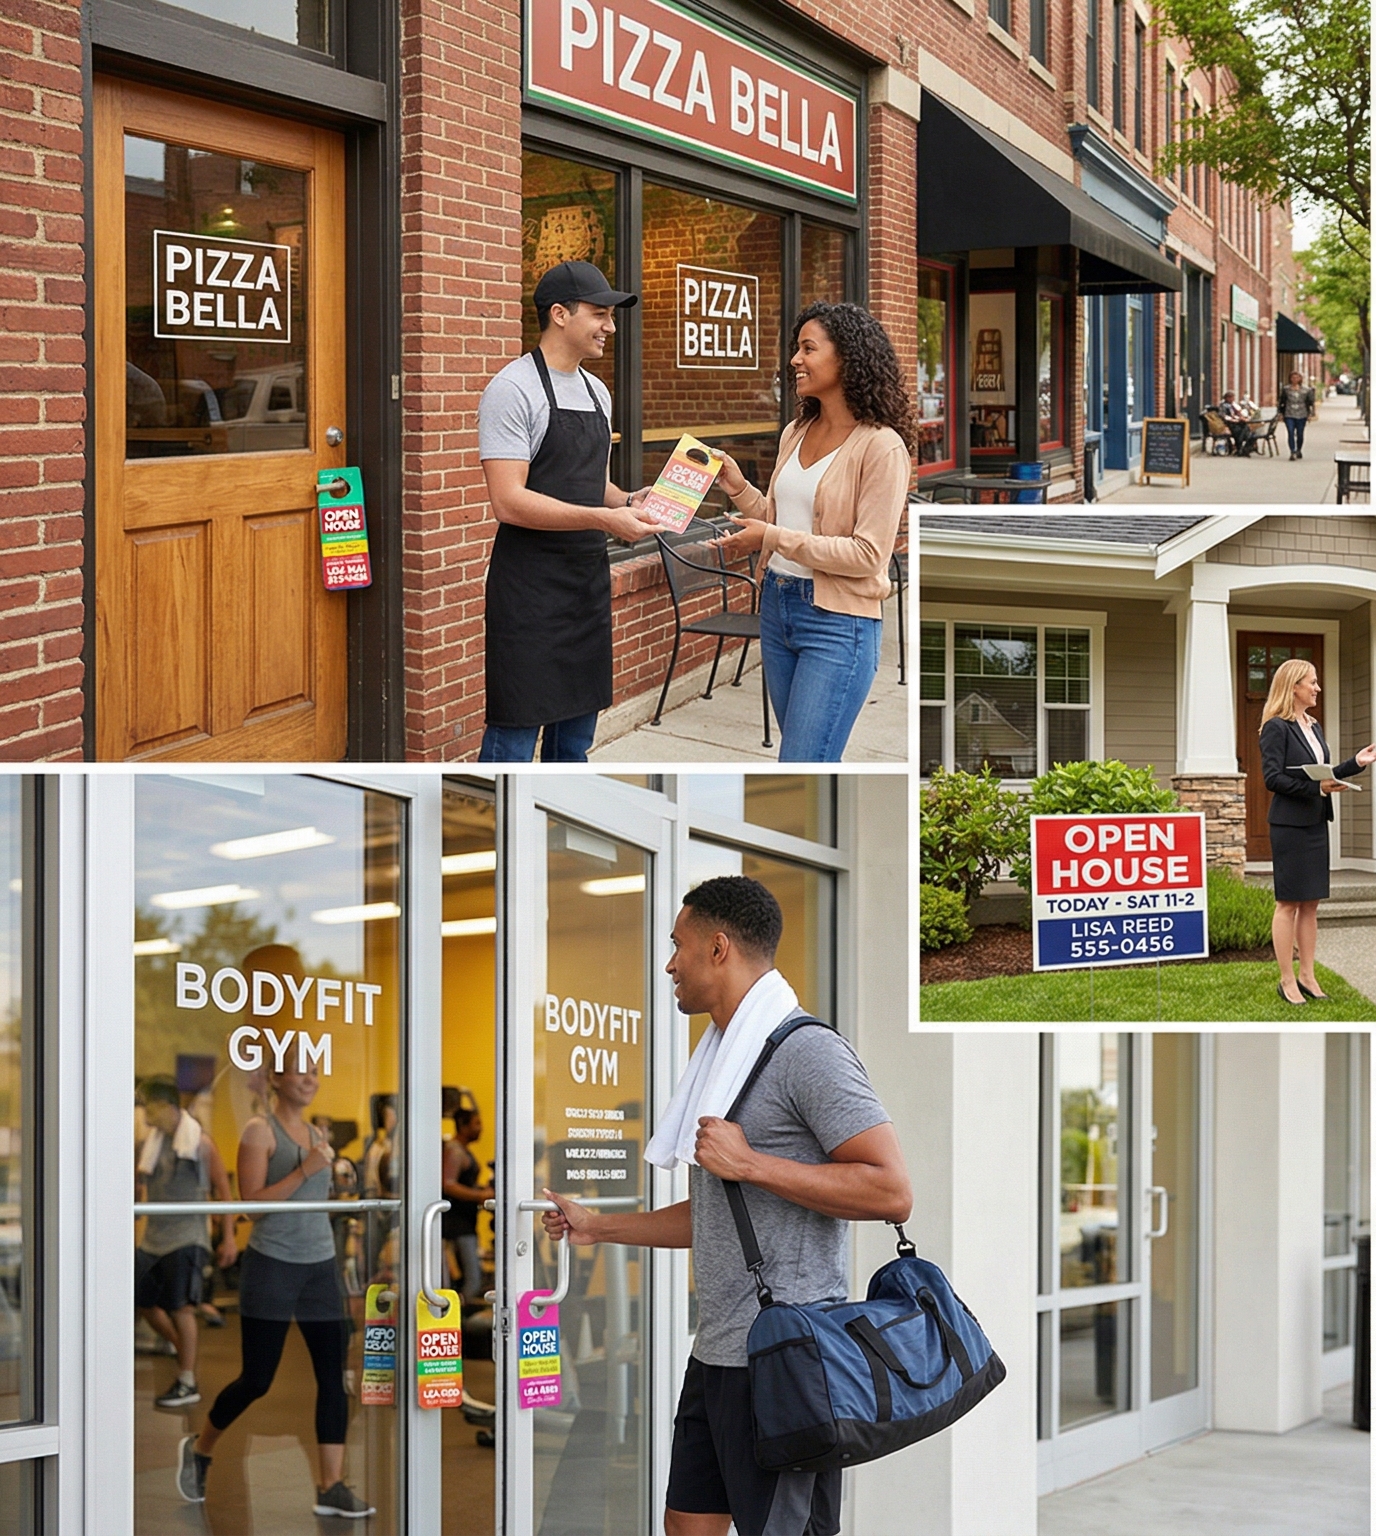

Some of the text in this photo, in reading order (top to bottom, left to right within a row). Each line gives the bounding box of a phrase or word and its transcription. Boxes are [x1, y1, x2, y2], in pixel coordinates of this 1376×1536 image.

[560, 0, 842, 173] PIZZA BELLA
[166, 244, 281, 292] PIZZA
[166, 289, 282, 331] BELLA
[684, 277, 753, 320] PIZZA
[684, 321, 753, 358] BELLA
[1064, 823, 1175, 853] OPEN
[1052, 856, 1190, 888] HOUSE
[1046, 897, 1109, 913] TODAY
[1127, 895, 1159, 909] SAT
[1164, 893, 1195, 907] 11-2
[1070, 935, 1175, 958] 555-0456
[1072, 917, 1174, 938] LISA REED
[176, 962, 382, 1026] BODYFIT
[545, 993, 641, 1045] BODYFIT
[229, 1025, 332, 1076] GYM
[570, 1045, 618, 1086] GYM
[421, 1332, 458, 1346] OPEN
[523, 1329, 556, 1344] OPEN
